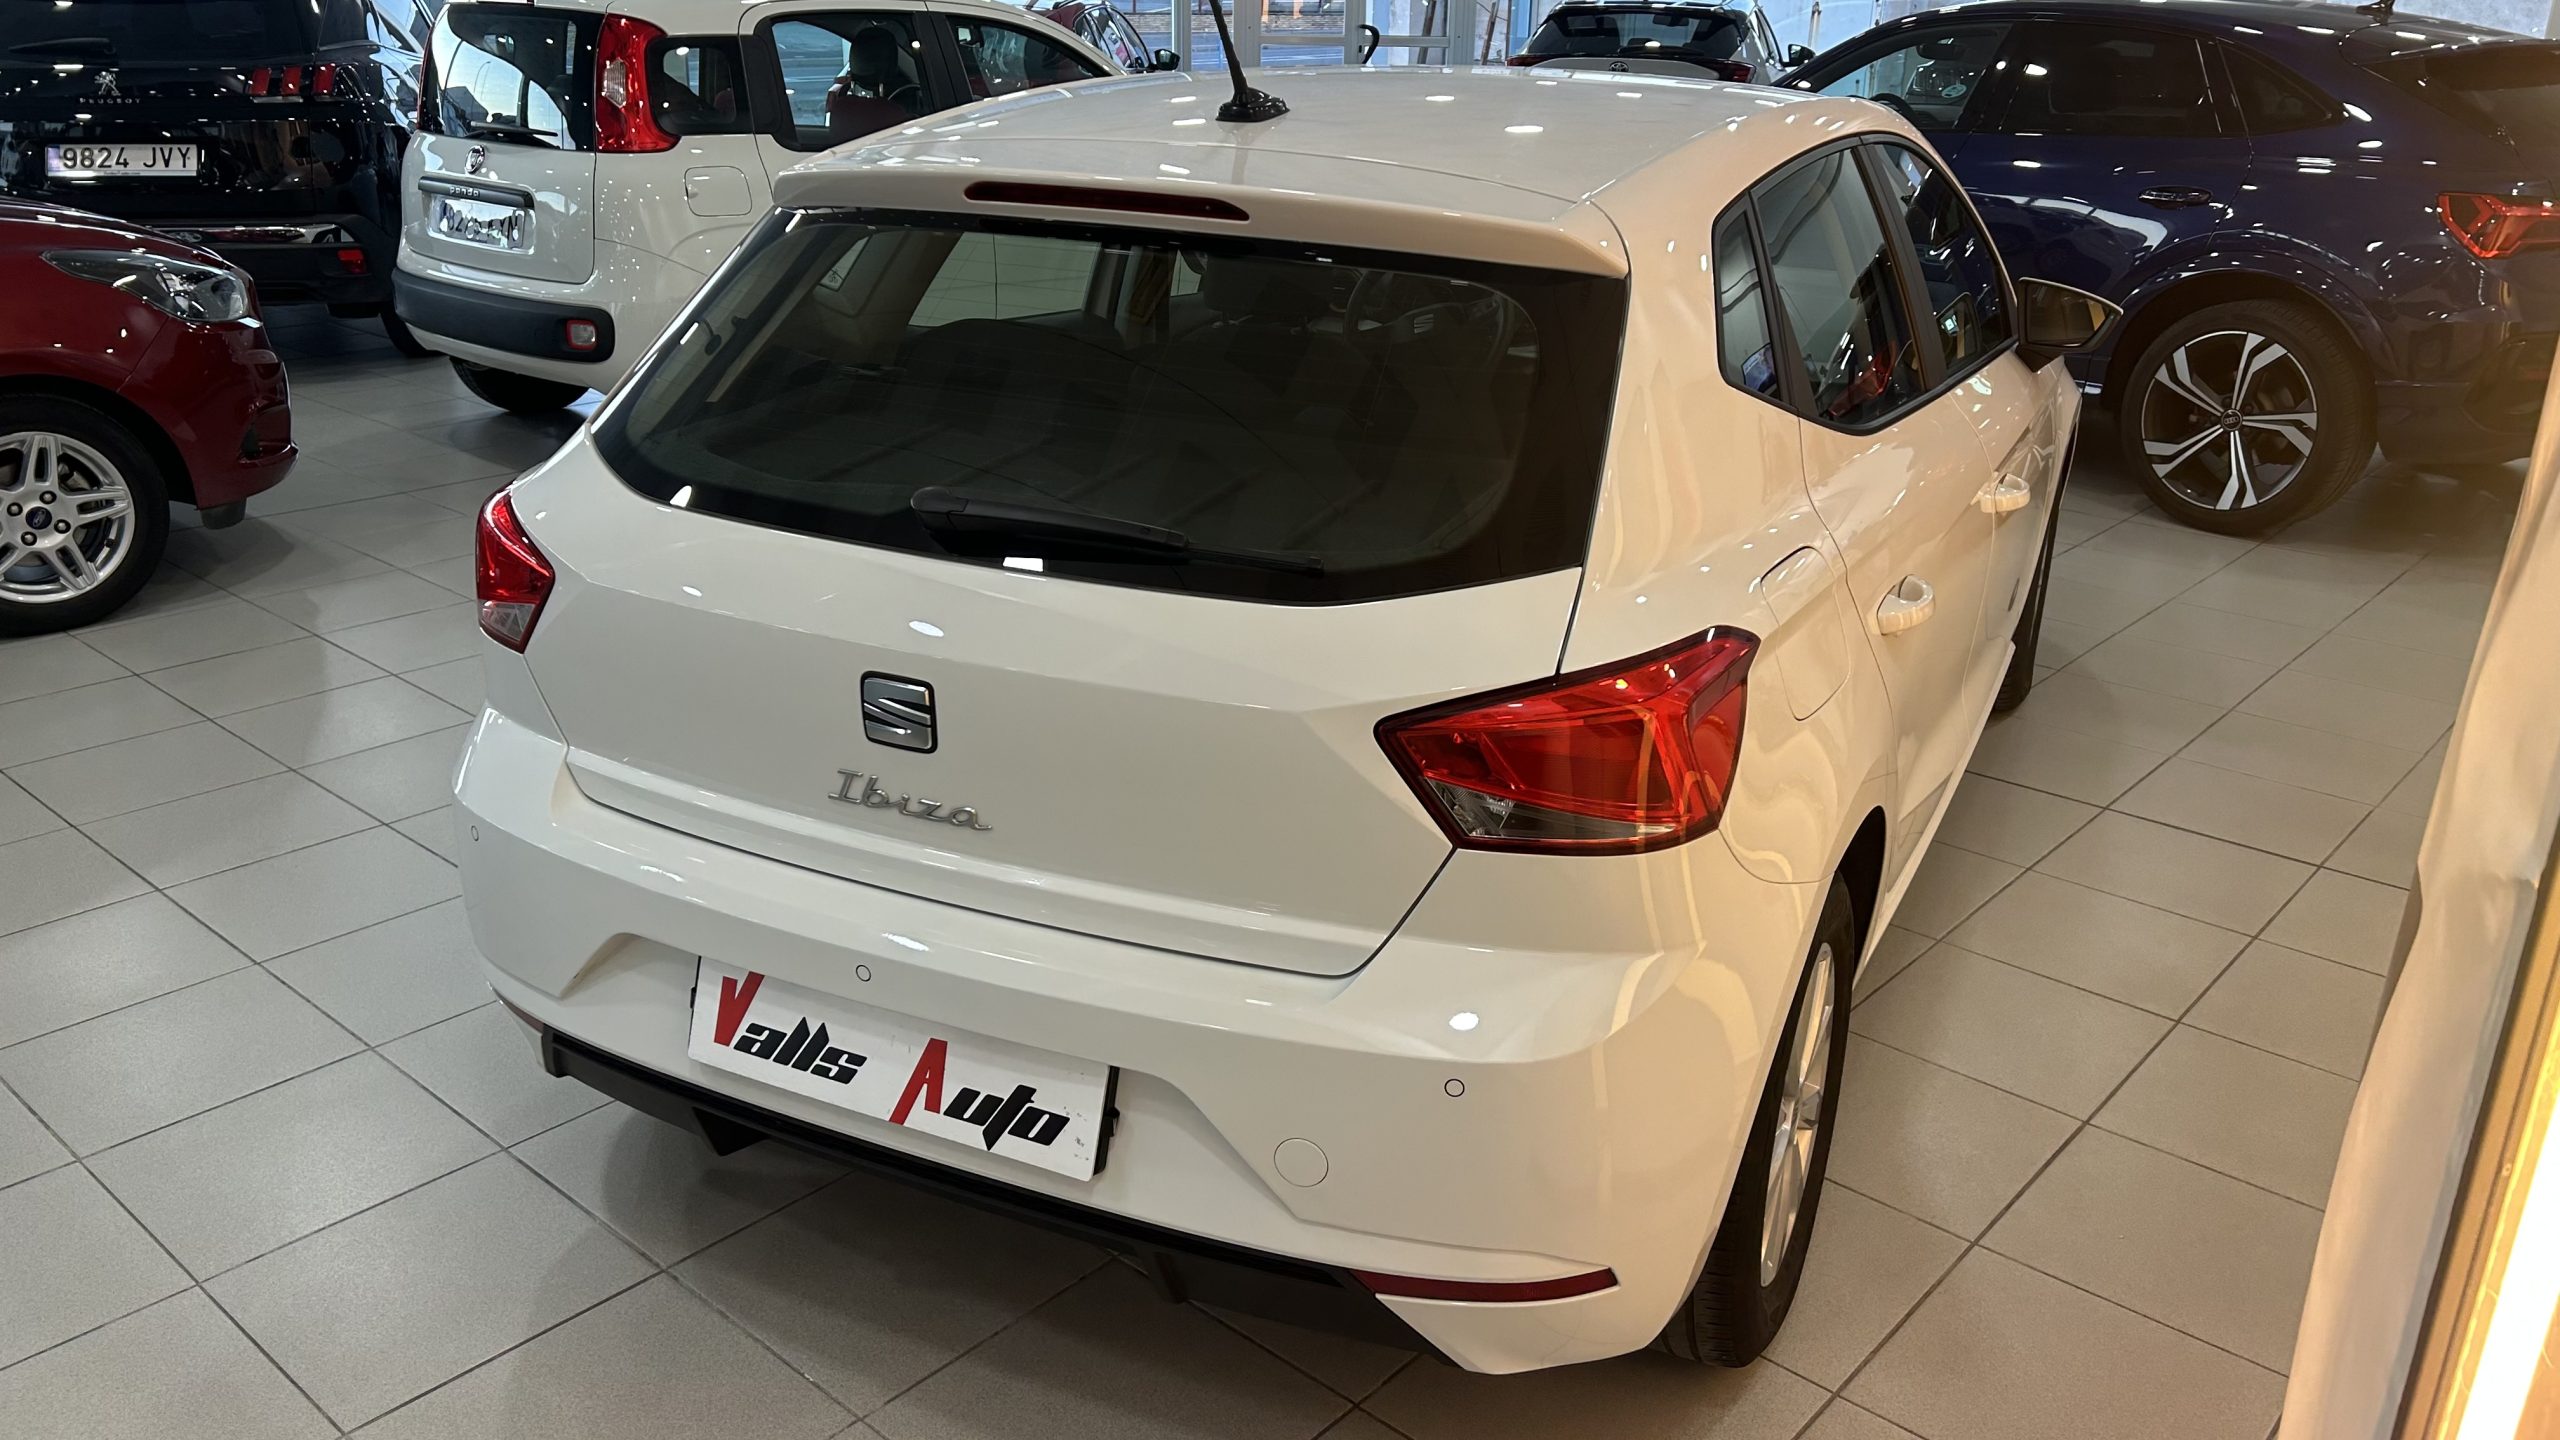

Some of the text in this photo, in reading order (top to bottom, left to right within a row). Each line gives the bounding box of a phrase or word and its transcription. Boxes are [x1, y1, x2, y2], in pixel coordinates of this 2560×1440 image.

[63, 147, 191, 169] 9824 JVY
[828, 768, 993, 831] Ibiza
[713, 971, 1070, 1151] Valls Auto
